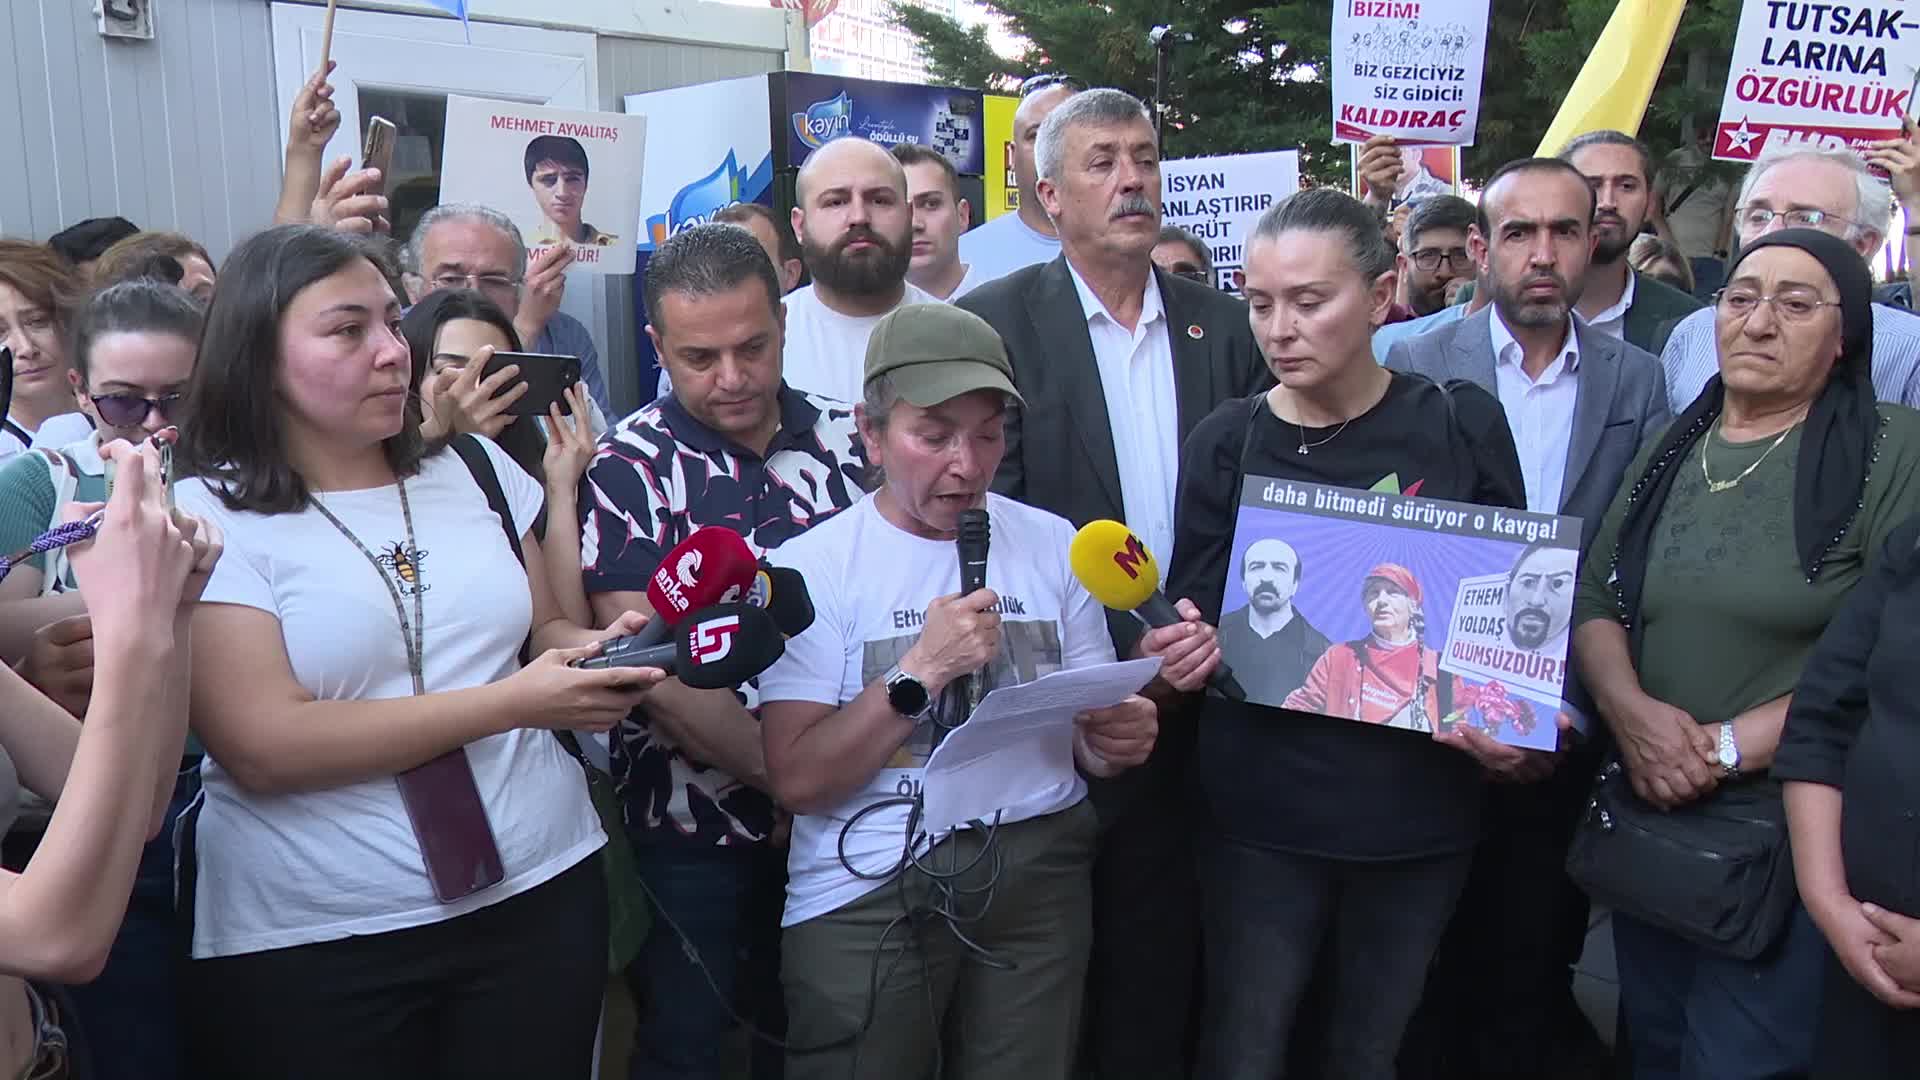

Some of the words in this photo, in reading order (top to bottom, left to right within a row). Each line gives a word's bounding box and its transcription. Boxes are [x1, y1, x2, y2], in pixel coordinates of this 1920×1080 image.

[1761, 37, 1887, 76] LARINA
[1354, 61, 1378, 78] BİZ
[1382, 64, 1465, 81] GEZİCİYİZ
[1374, 83, 1398, 100] SİZ
[1403, 85, 1463, 101] GİDİCİ!
[1736, 68, 1909, 119] ÖZGÜRLÜK
[491, 115, 555, 134] MEHMET
[557, 123, 618, 142] AYVALITAŞ
[1341, 104, 1467, 132] KALDIRAÇ
[1167, 173, 1225, 193] İSYAN
[1160, 194, 1272, 218] ANLAŞTIRIR
[1263, 482, 1308, 507] daha
[1314, 491, 1386, 517] bitmedi
[1391, 504, 1467, 530] sürüyor
[1473, 515, 1484, 530] o
[1492, 512, 1559, 542] kavga!
[656, 567, 690, 612] anka
[1463, 587, 1504, 606] ETHEM
[1459, 615, 1505, 641] YOLDAŞ
[689, 631, 699, 658] halk
